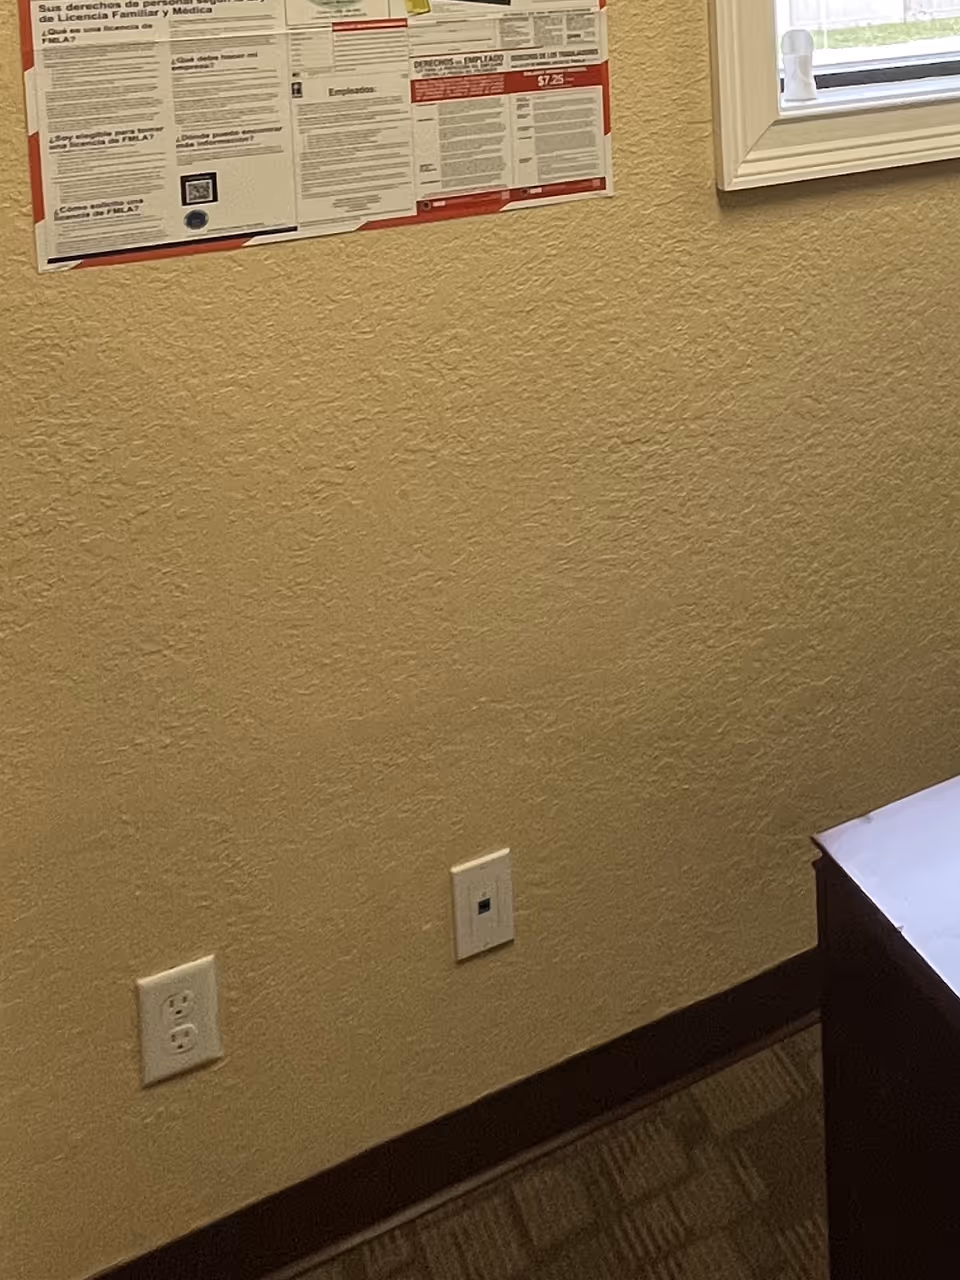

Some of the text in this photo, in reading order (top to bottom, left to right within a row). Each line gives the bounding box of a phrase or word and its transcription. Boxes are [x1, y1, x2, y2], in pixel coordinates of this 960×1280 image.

[38, 4, 62, 13] Sus
[65, 2, 122, 11] derechos
[125, 0, 139, 8] de
[39, 6, 212, 23] de Licencia Familiar y Médica
[41, 26, 67, 36] ¿Qué
[414, 58, 454, 69] DERECHOS
[464, 54, 504, 65] EMPLEADO
[537, 74, 564, 86] $7.25
[328, 85, 377, 97] Empleados:
